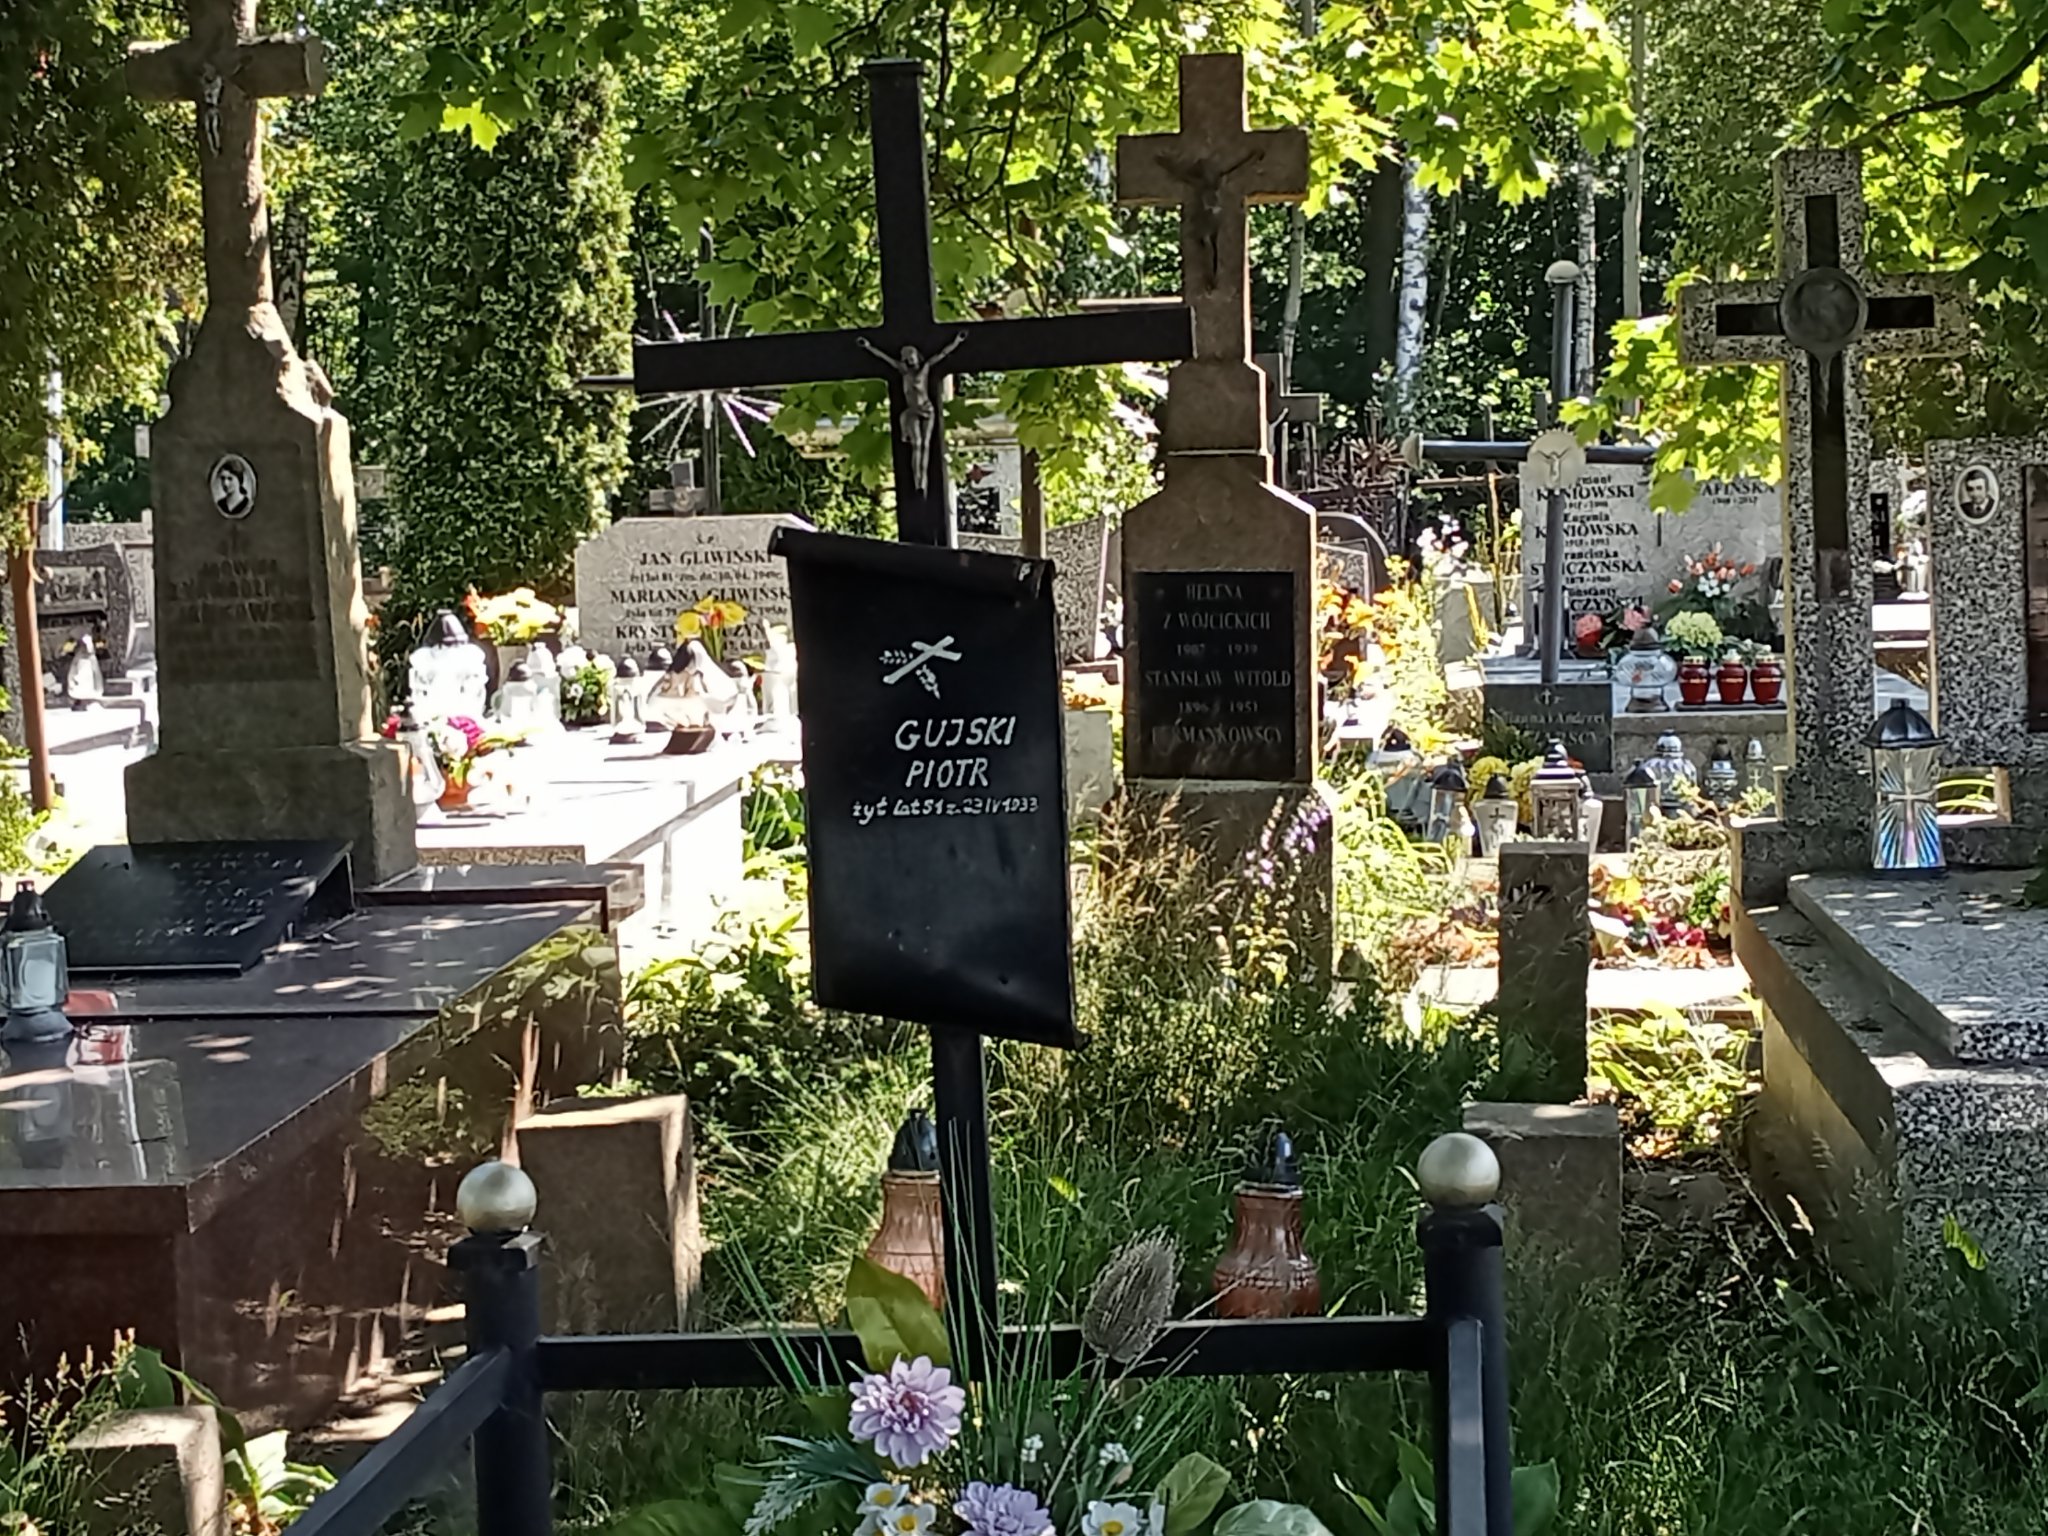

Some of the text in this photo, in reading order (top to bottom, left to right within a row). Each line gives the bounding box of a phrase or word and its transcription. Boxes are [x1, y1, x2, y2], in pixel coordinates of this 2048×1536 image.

[1536, 485, 1634, 501] KNIOWSKI
[640, 552, 671, 565] JAN
[1564, 549, 1619, 560] ranciszka
[611, 582, 791, 604] MARIANNA GLIWIŃSK
[1186, 584, 1242, 600] HELENA
[1233, 670, 1291, 687] WITOLD
[895, 716, 1016, 751] GUJSKI
[905, 757, 988, 789] PIOTR
